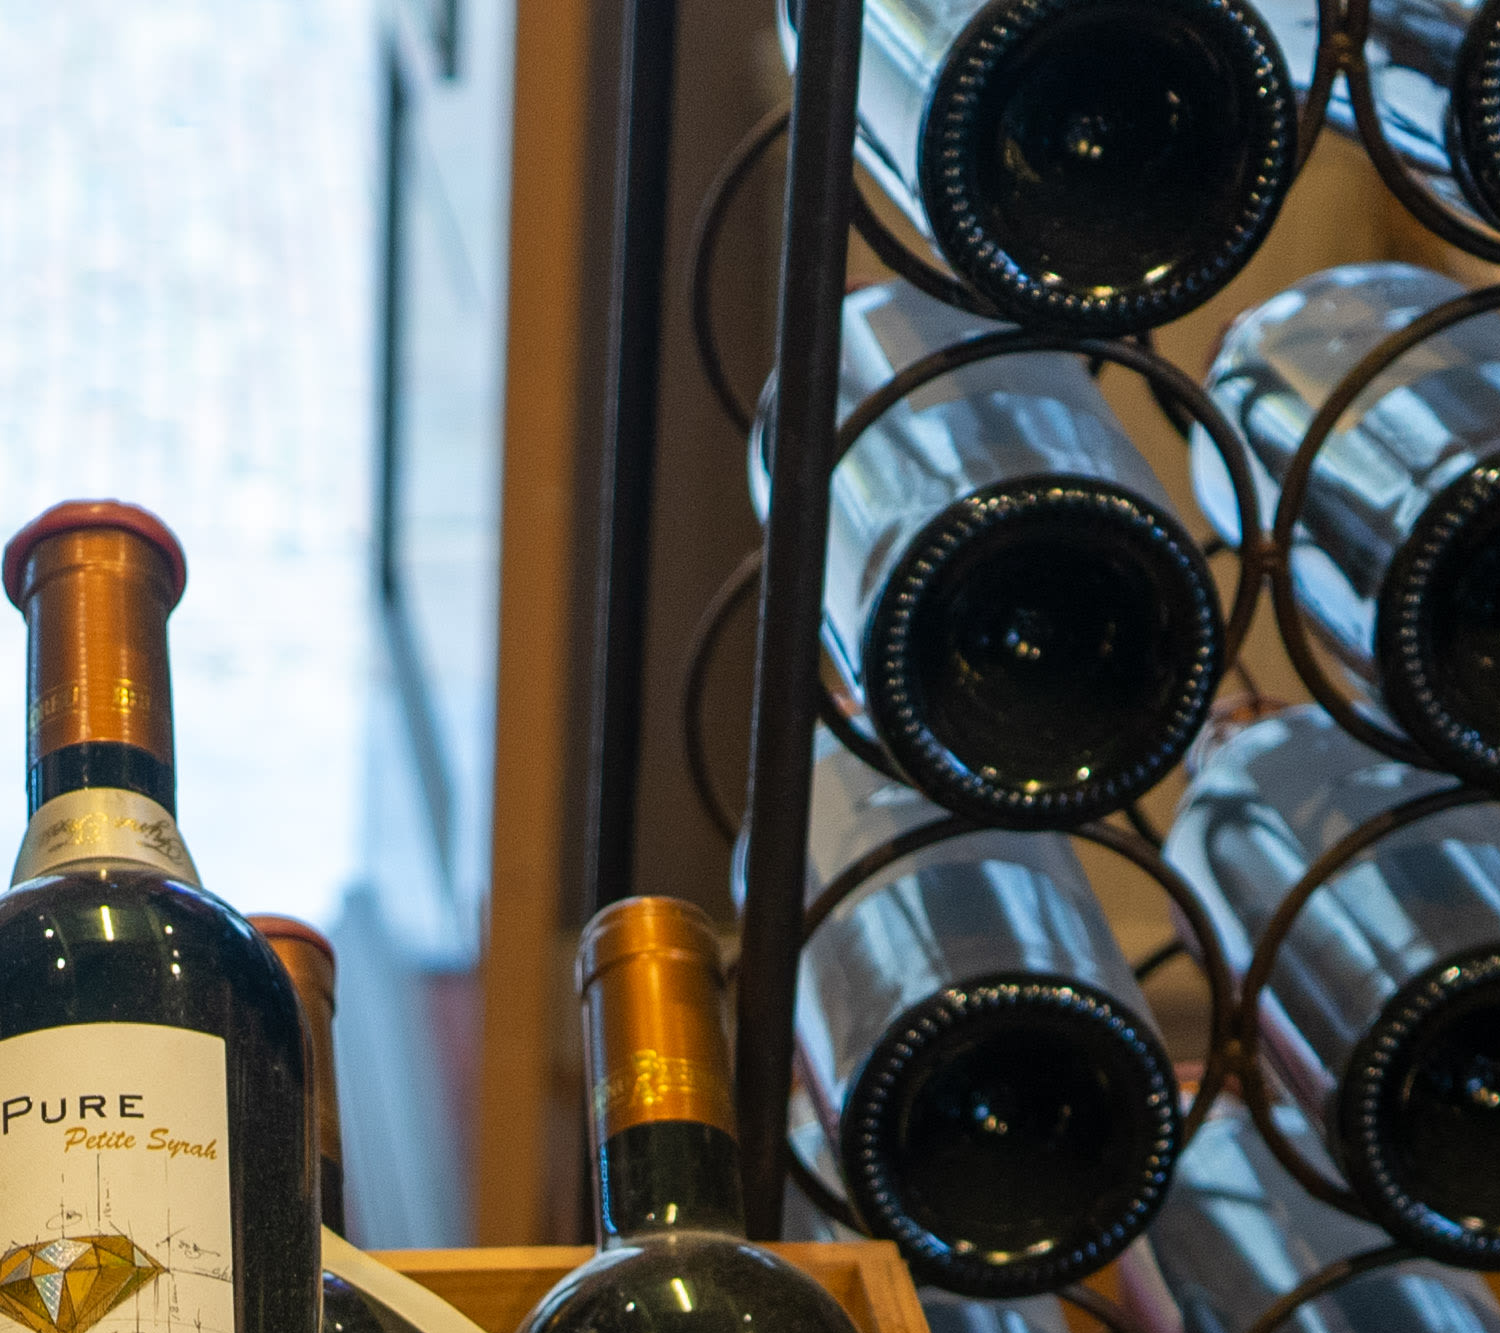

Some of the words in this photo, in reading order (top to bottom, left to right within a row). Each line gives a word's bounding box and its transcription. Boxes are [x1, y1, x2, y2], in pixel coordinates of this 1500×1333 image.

[3, 1094, 145, 1135] PURE
[64, 1127, 137, 1153] Petite
[146, 1128, 218, 1161] Syrah
